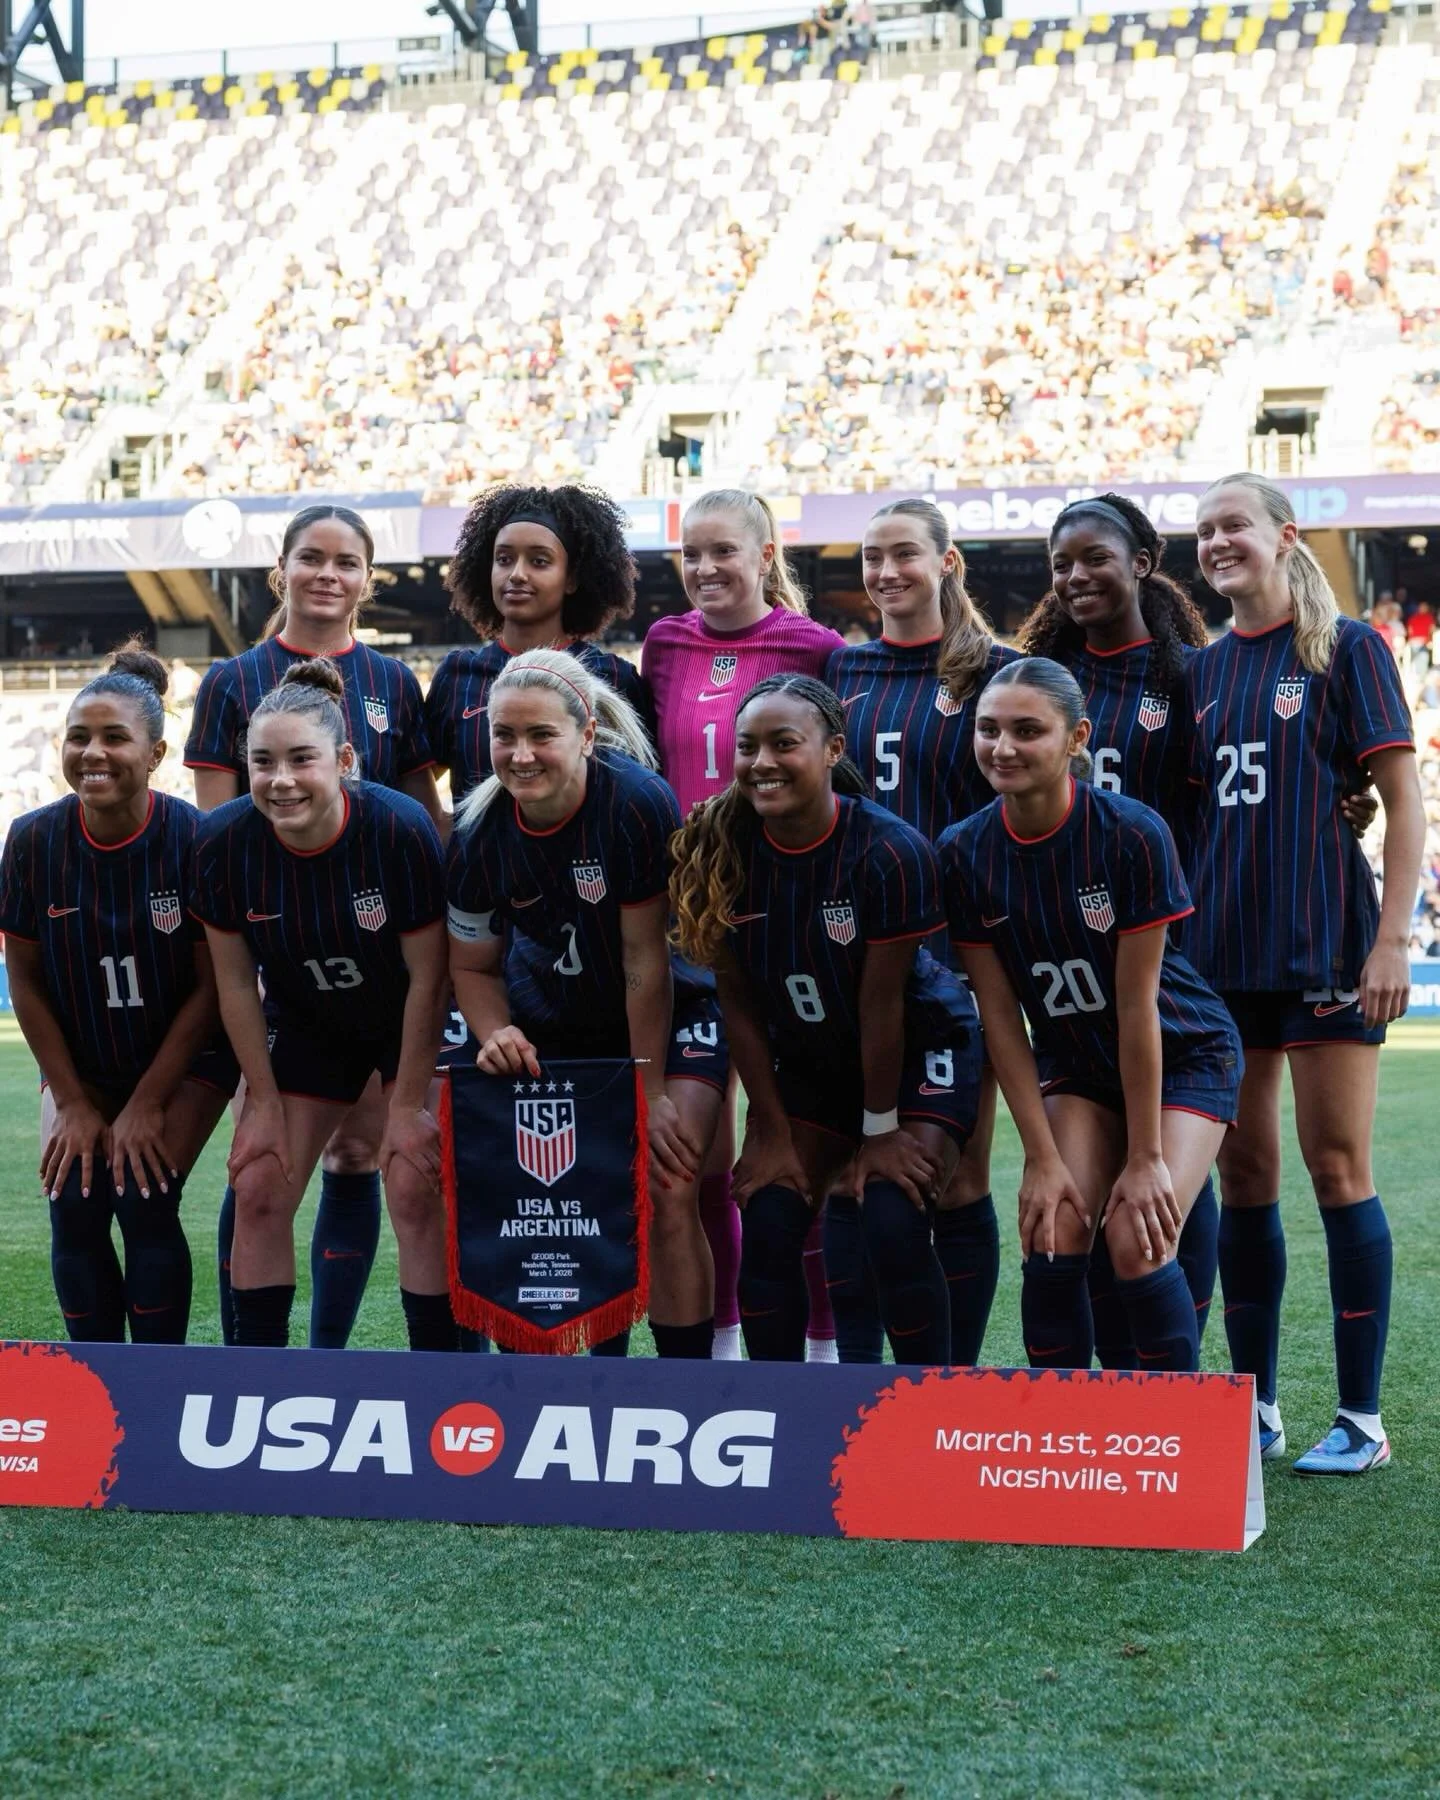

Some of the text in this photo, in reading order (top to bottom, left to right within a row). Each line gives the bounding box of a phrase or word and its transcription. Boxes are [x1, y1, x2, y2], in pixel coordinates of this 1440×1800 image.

[715, 656, 736, 670] USA
[1278, 684, 1304, 699] USA
[366, 703, 387, 717] USA
[1143, 698, 1169, 713] USA
[703, 723, 720, 779] 1
[875, 732, 902, 791] 5
[1216, 742, 1266, 807] 25
[575, 867, 602, 882] USA
[152, 899, 179, 914] USA
[355, 897, 383, 913] USA
[1081, 893, 1110, 911] USA
[824, 909, 852, 924] USA
[99, 956, 145, 1008] 11
[304, 957, 364, 991] 13
[1031, 958, 1107, 1017] 20
[785, 974, 826, 1023] 8
[518, 1101, 574, 1138] USA
[517, 1198, 582, 1217] USA VS
[500, 1218, 601, 1237] ARGENTINA
[556, 1252, 571, 1261] Park
[528, 1269, 547, 1277] March
[554, 1269, 573, 1277] 2026
[564, 1290, 579, 1299] CUP
[178, 1393, 414, 1476] USA
[513, 1404, 777, 1488] ARG
[935, 1428, 1181, 1458] March 1st, 2026
[0, 1455, 39, 1473] VISA
[978, 1465, 1179, 1495] Nashville, TN
